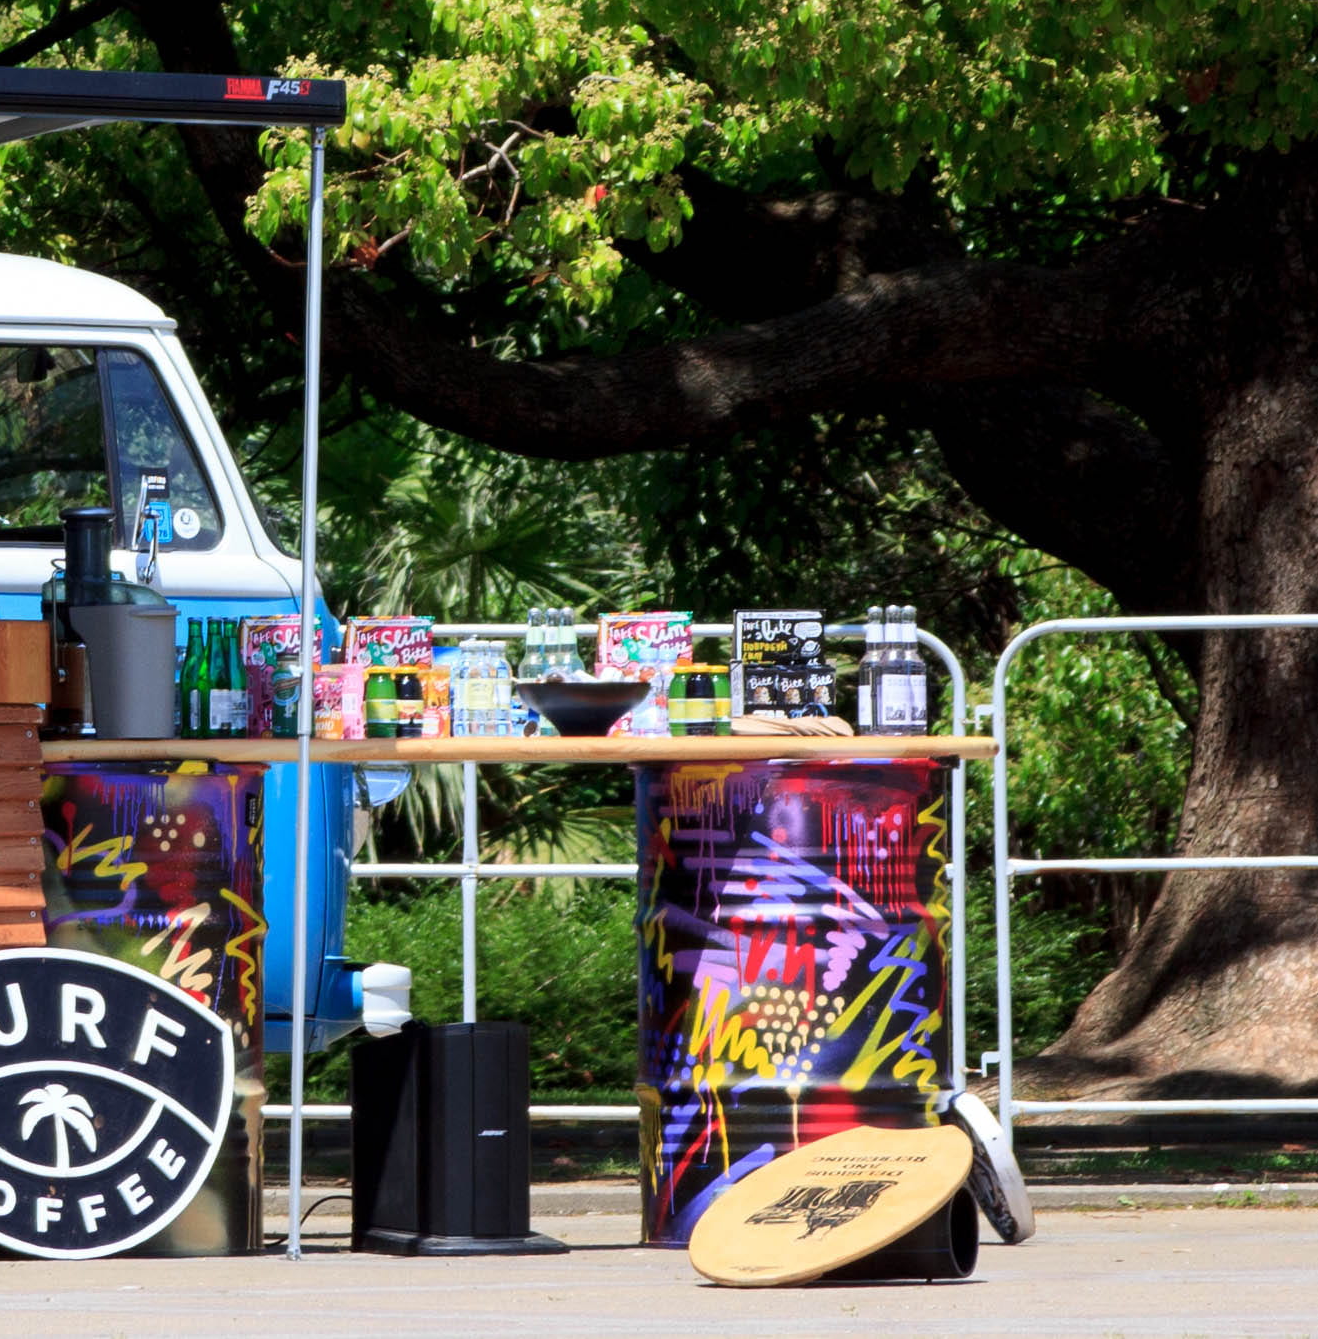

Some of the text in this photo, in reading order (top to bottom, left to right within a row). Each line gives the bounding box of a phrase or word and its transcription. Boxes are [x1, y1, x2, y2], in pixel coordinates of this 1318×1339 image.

[380, 628, 429, 654] Slim
[635, 623, 688, 648] Slim
[761, 618, 793, 642] Bite
[400, 646, 432, 664] Bite
